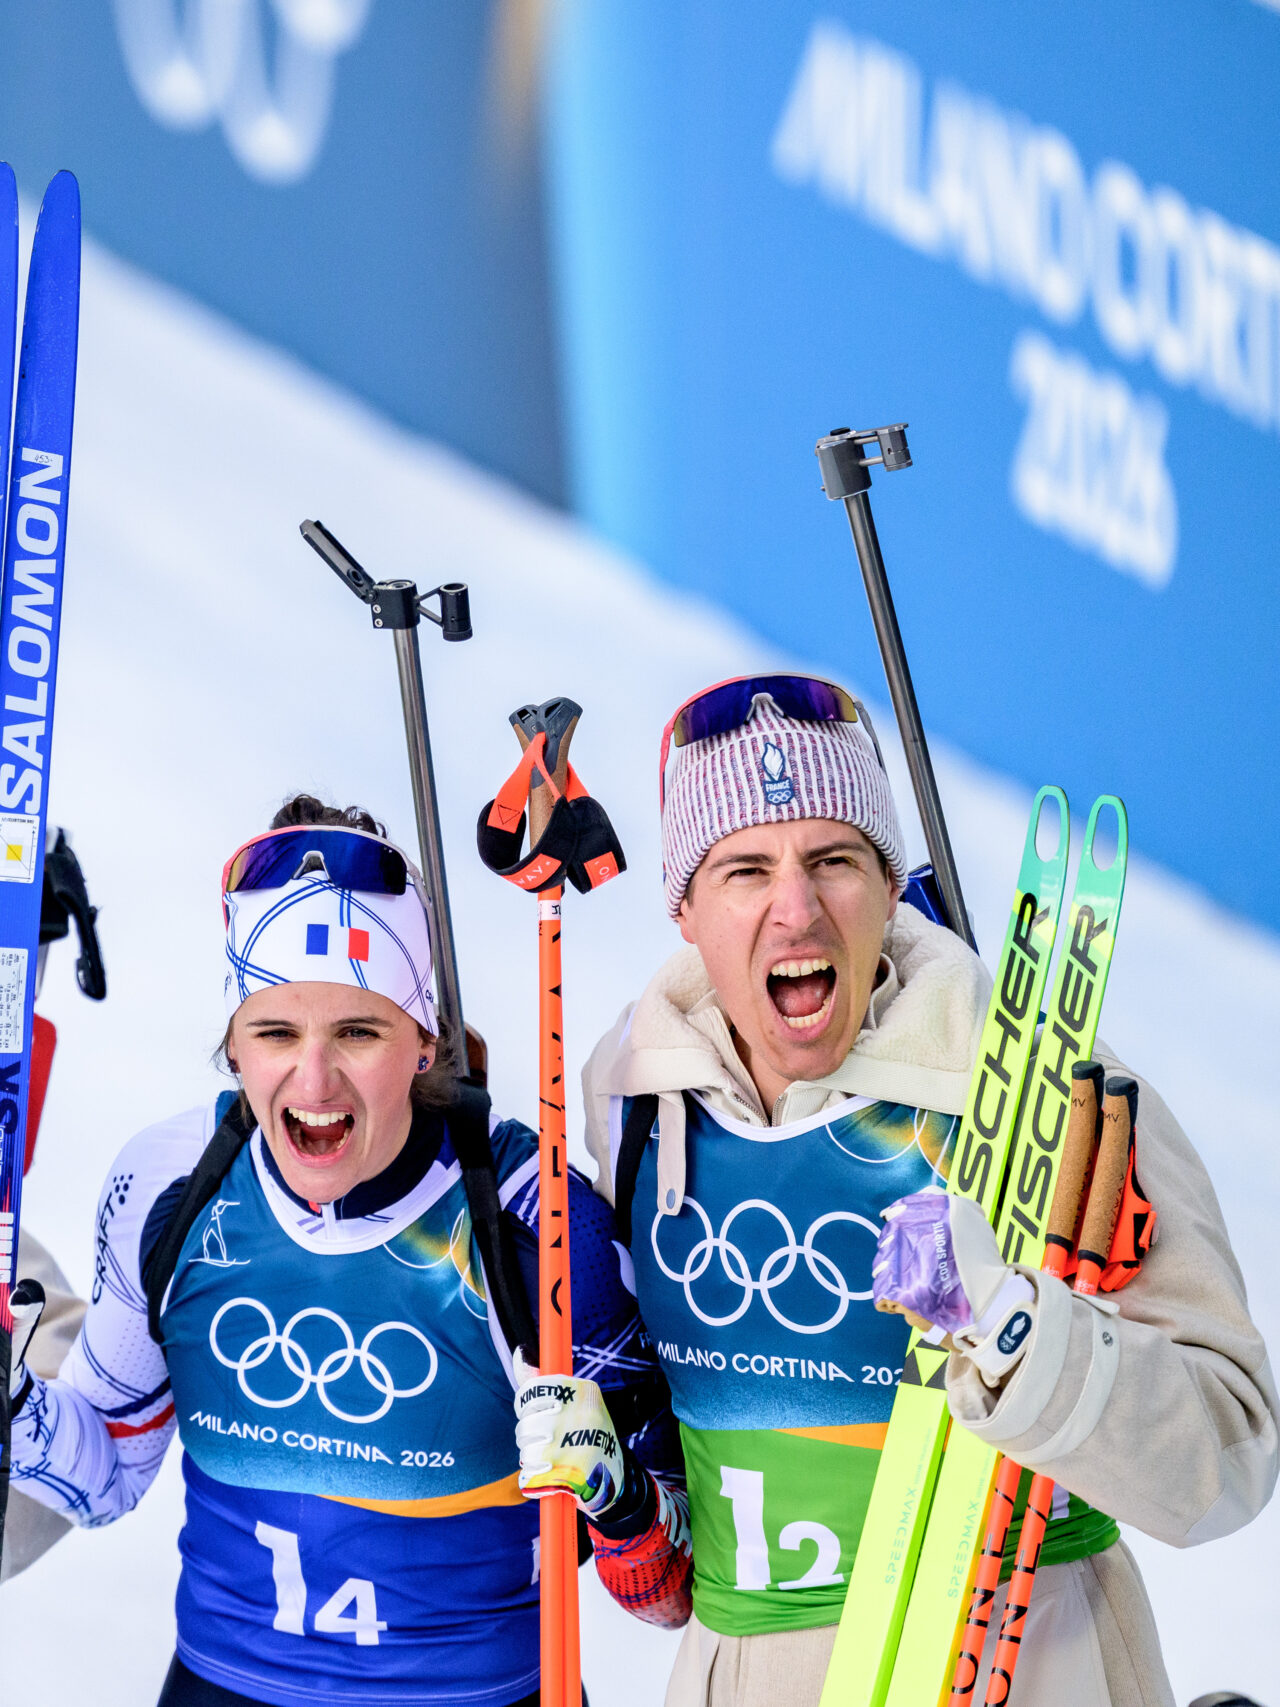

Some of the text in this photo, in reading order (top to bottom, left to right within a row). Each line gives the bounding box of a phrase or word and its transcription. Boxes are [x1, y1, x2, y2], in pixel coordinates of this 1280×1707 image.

[957, 892, 1049, 1205] SCHER
[92, 1191, 115, 1305] CRAFT
[938, 1261, 951, 1282] COQ
[658, 1340, 727, 1371] MILANO
[732, 1353, 856, 1383] CORTINA
[520, 1385, 576, 1409] KINETIXX
[189, 1411, 456, 1468] MILANO CORTINA 2026
[560, 1429, 616, 1458] KINETIXX
[885, 1487, 918, 1585] SPEEDMAX
[947, 1501, 979, 1598] SPEEDMAX
